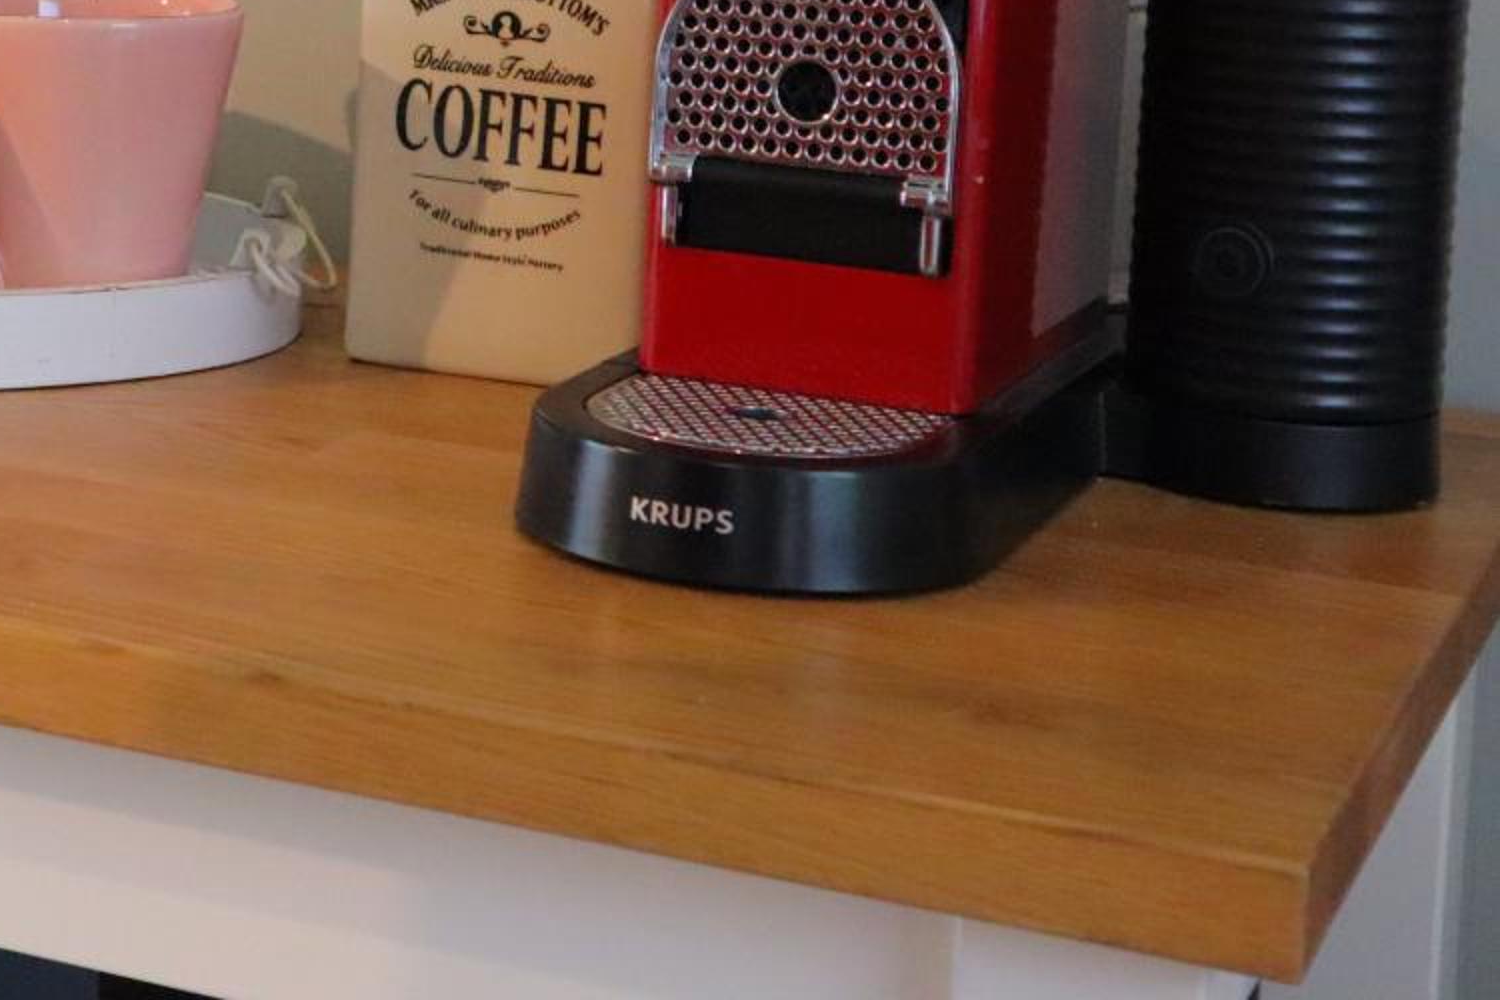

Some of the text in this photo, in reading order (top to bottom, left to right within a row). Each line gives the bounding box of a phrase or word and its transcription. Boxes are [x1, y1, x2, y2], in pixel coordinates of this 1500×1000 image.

[413, 44, 596, 89] Delicious Traditions
[395, 78, 607, 176] COFFEE
[431, 207, 452, 223] all
[451, 216, 512, 242] culinary
[515, 209, 581, 241] purposes
[629, 496, 735, 534] KRUPS
